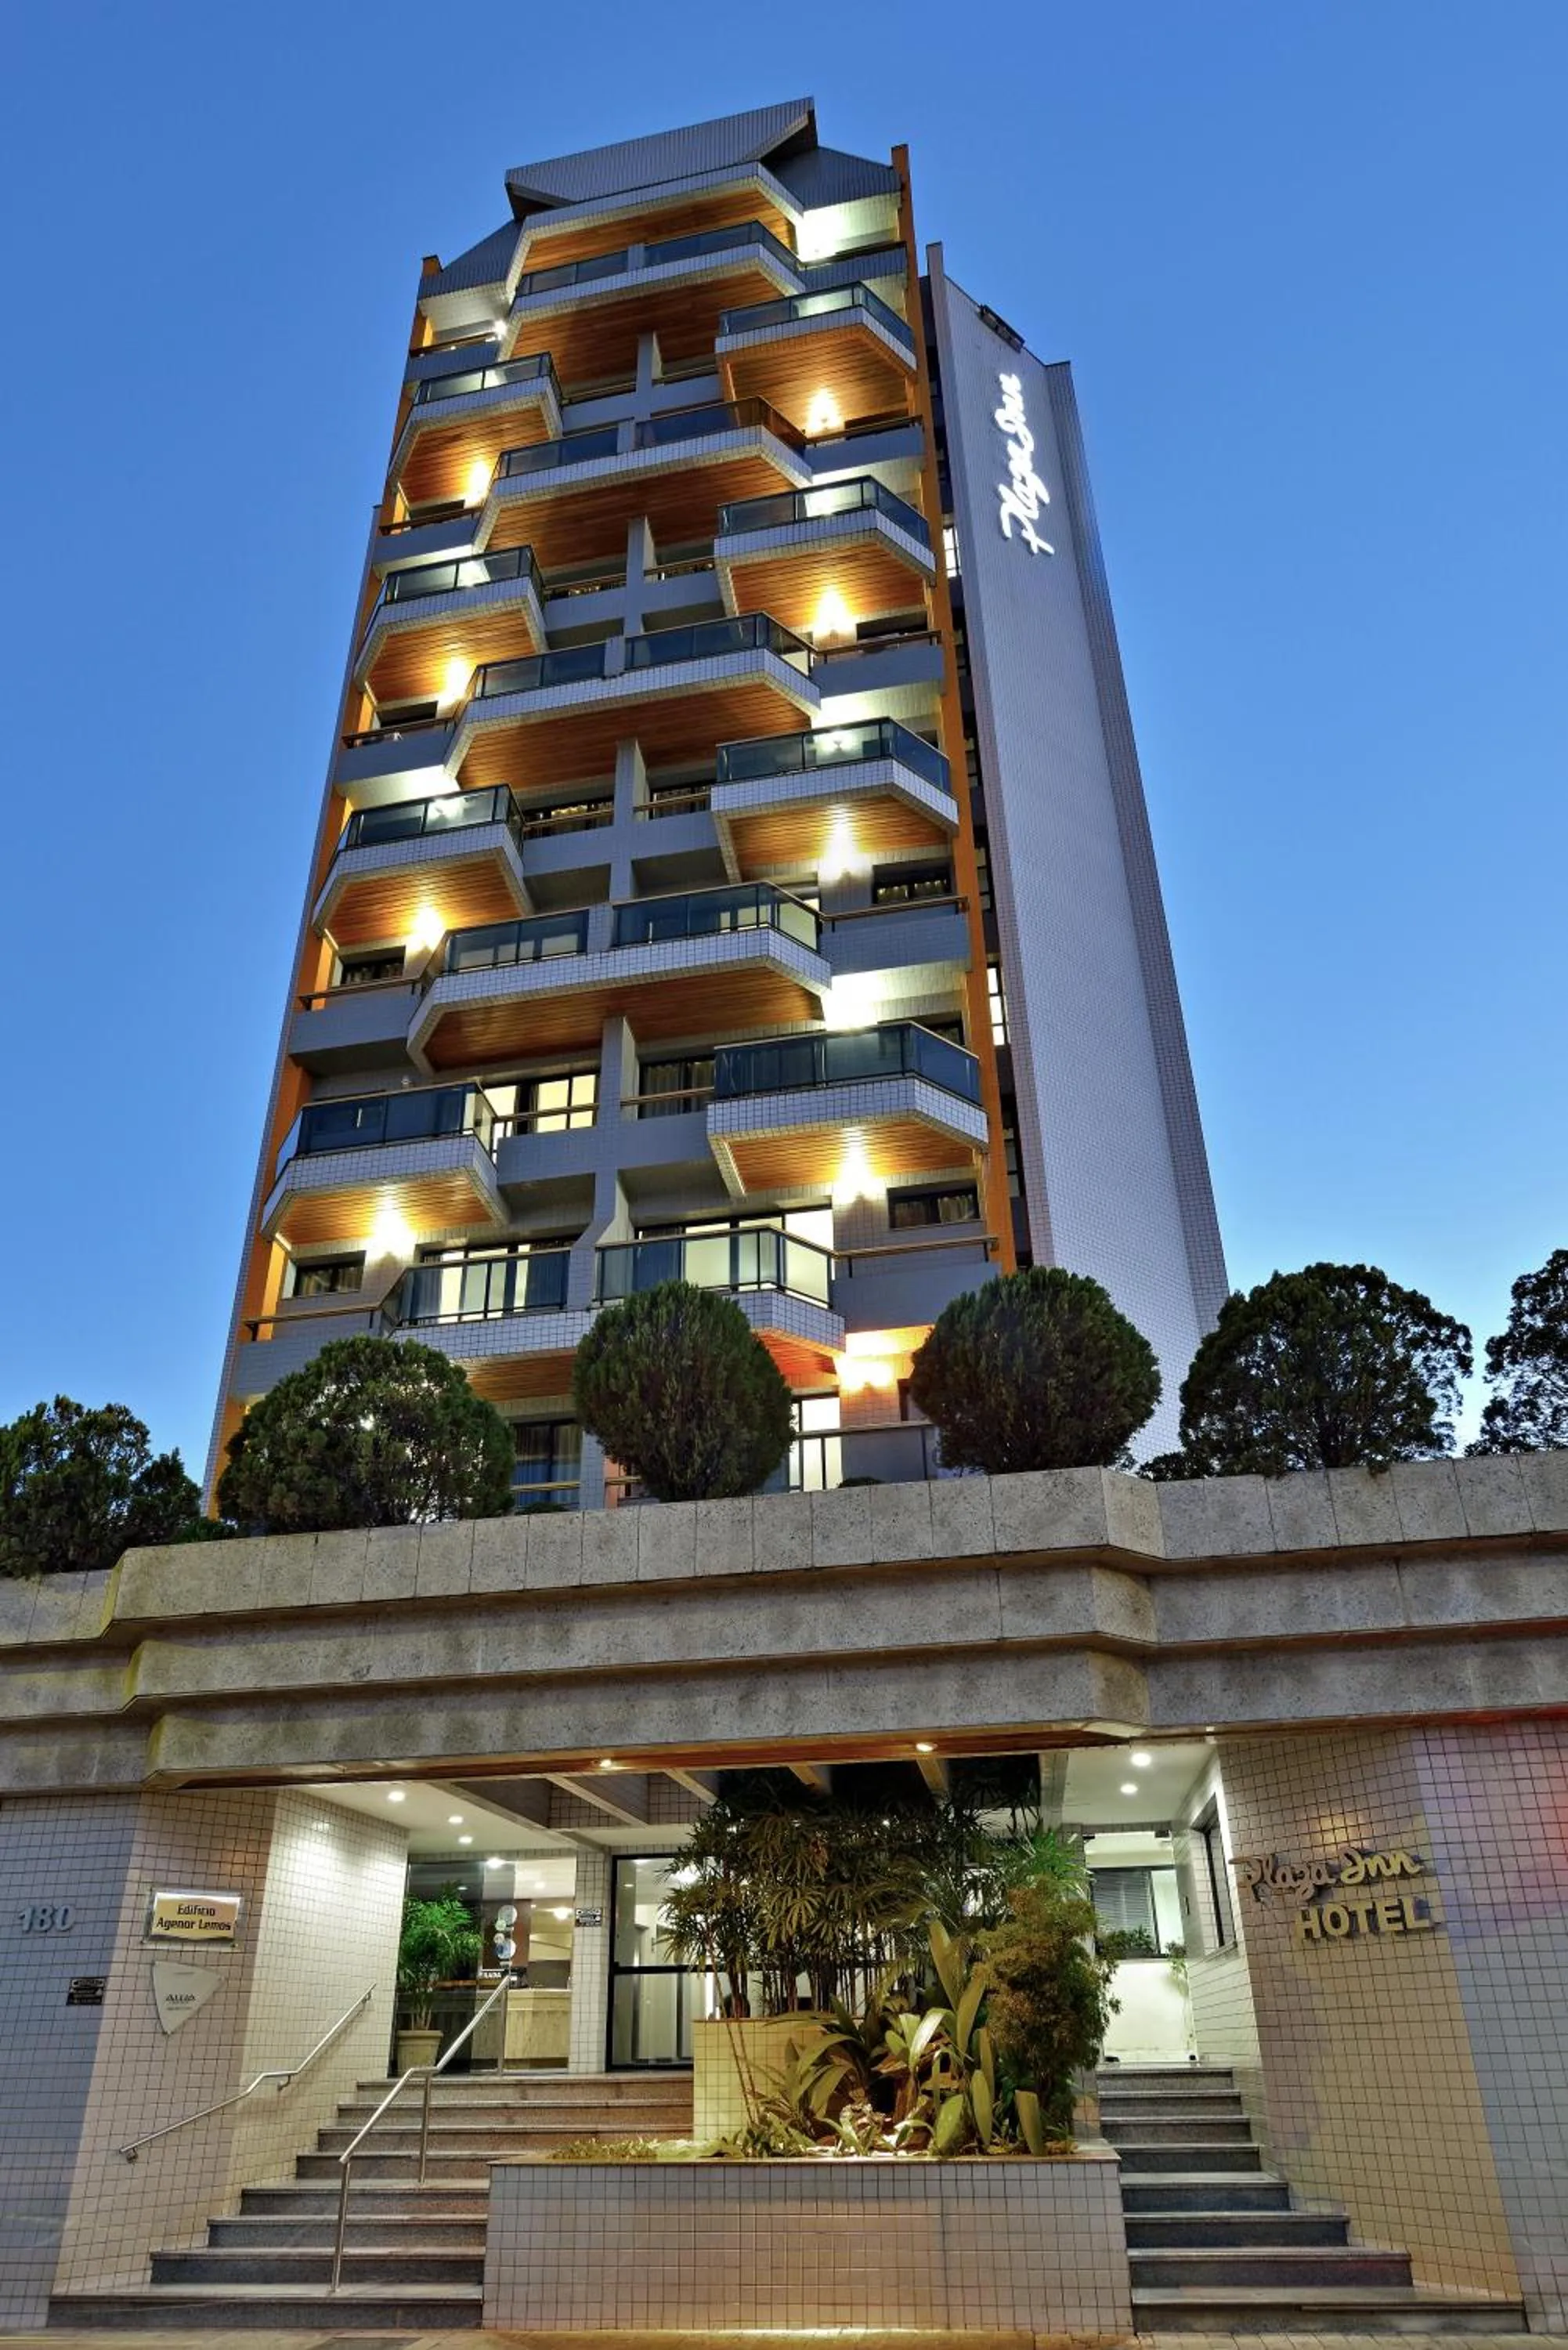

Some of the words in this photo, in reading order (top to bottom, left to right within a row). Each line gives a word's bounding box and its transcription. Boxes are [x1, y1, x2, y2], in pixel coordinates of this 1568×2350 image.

[995, 373, 1035, 451] Inn
[998, 439, 1054, 555] Plaza
[1229, 1854, 1335, 1907] Plaza
[1339, 1847, 1423, 1884] Inn
[18, 1905, 76, 1932] 180
[157, 1917, 196, 1931] Agenor
[198, 1919, 232, 1931] Lemos
[1294, 1896, 1429, 1940] HOTEL
